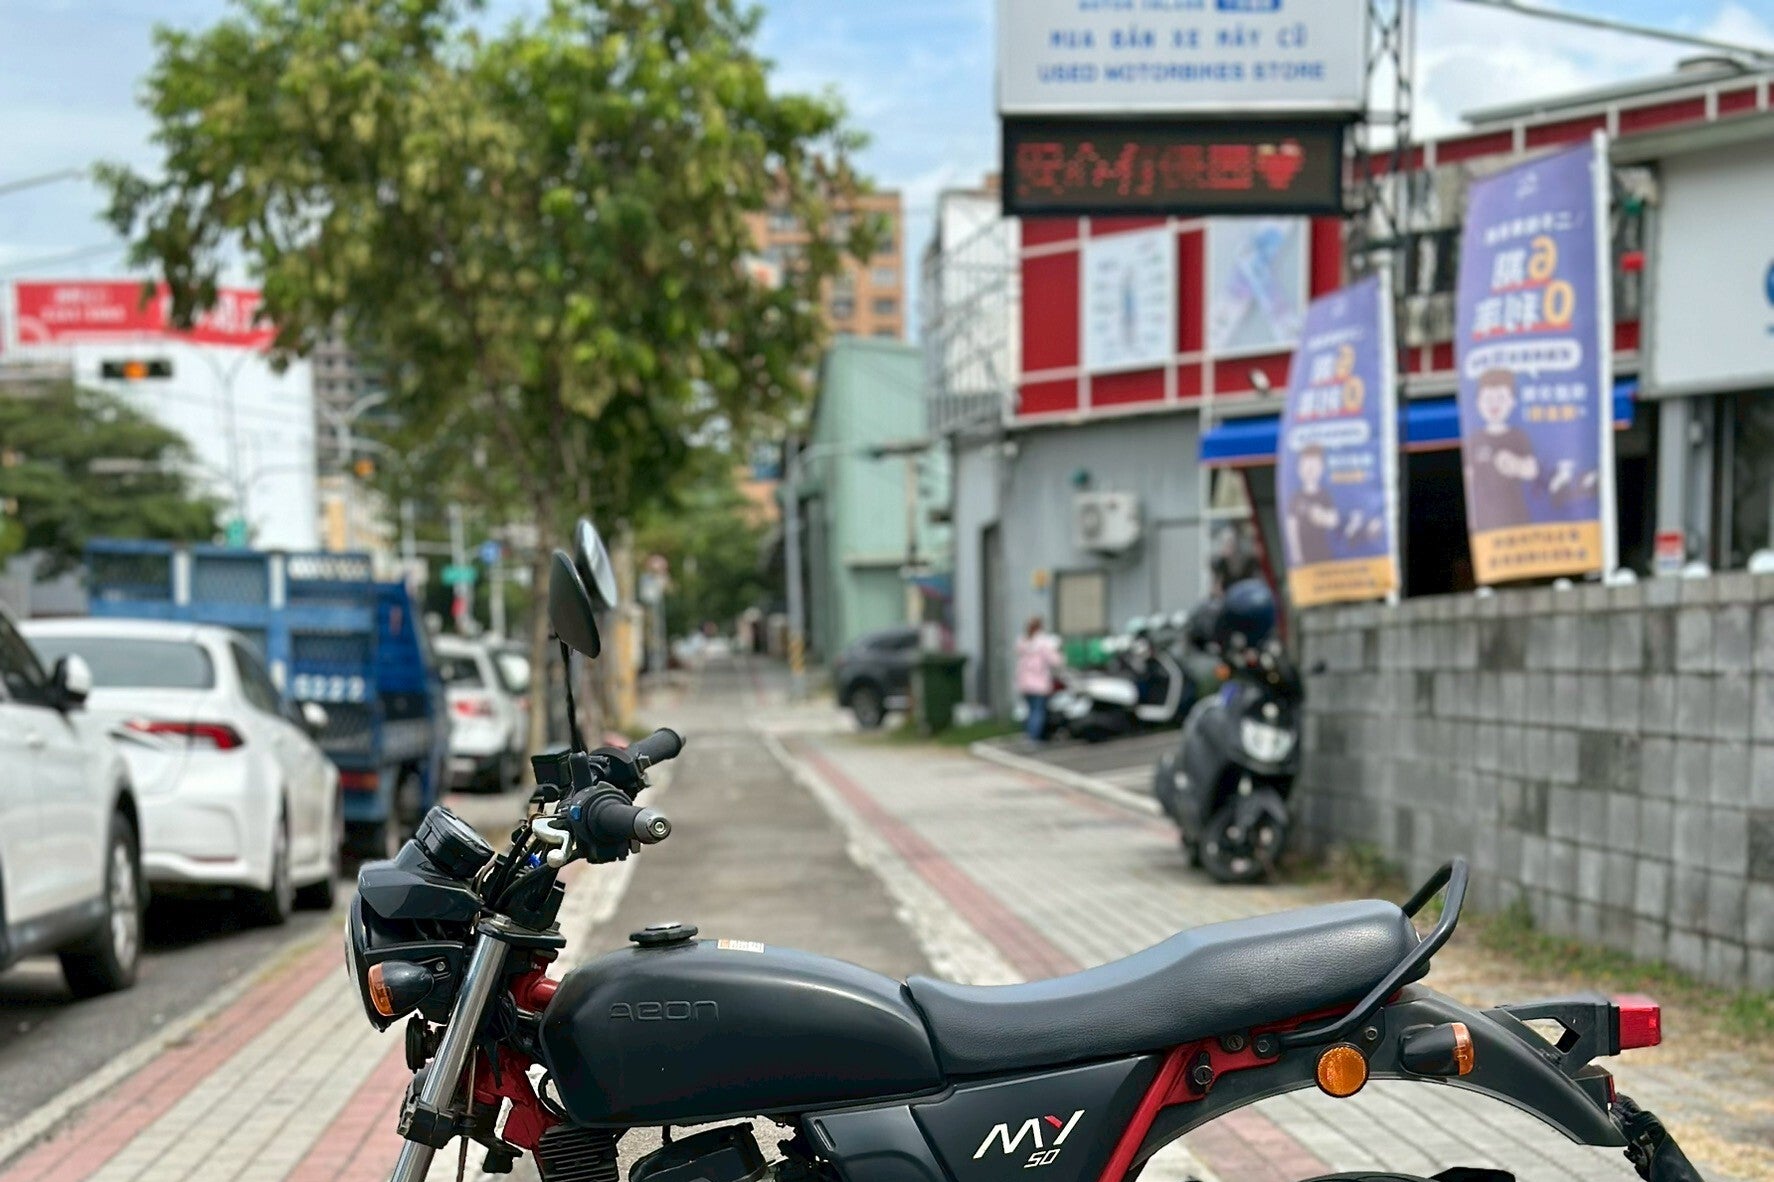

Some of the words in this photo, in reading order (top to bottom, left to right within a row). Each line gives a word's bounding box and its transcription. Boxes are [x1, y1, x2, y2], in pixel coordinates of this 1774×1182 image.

[1050, 29, 1094, 48] MUA
[1037, 64, 1096, 82] USED
[1105, 62, 1244, 82] MOTORBIKES
[1251, 61, 1326, 81] STORE
[973, 1109, 1085, 1159] MY
[1023, 1148, 1061, 1168] 50
